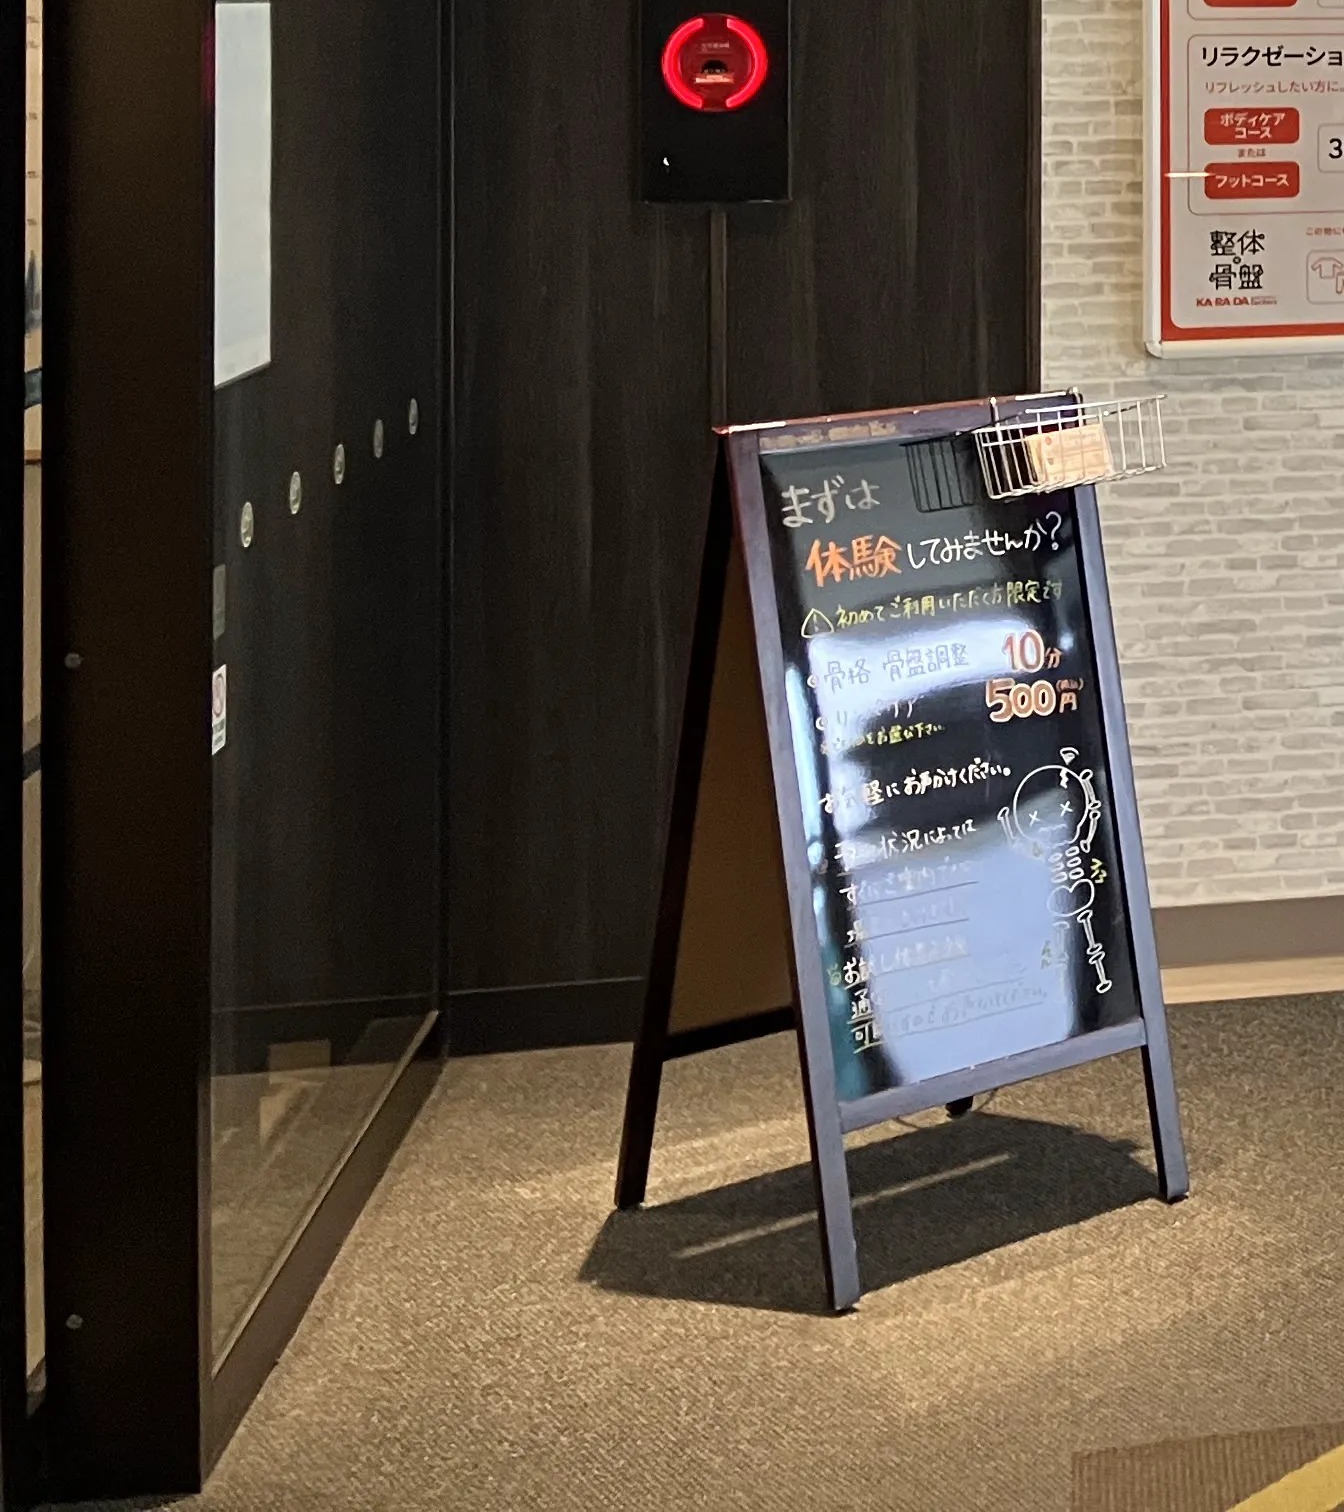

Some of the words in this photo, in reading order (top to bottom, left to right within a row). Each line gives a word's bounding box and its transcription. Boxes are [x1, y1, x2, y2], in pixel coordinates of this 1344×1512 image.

[1219, 112, 1286, 127] ボディケア
[1233, 125, 1273, 140] コース
[1214, 173, 1290, 188] フットコース
[1209, 228, 1266, 257] 整体
[1208, 263, 1264, 291] 骨盤
[781, 474, 881, 528] まずは
[1001, 627, 1064, 673] 10分
[986, 676, 1078, 723] 500円
